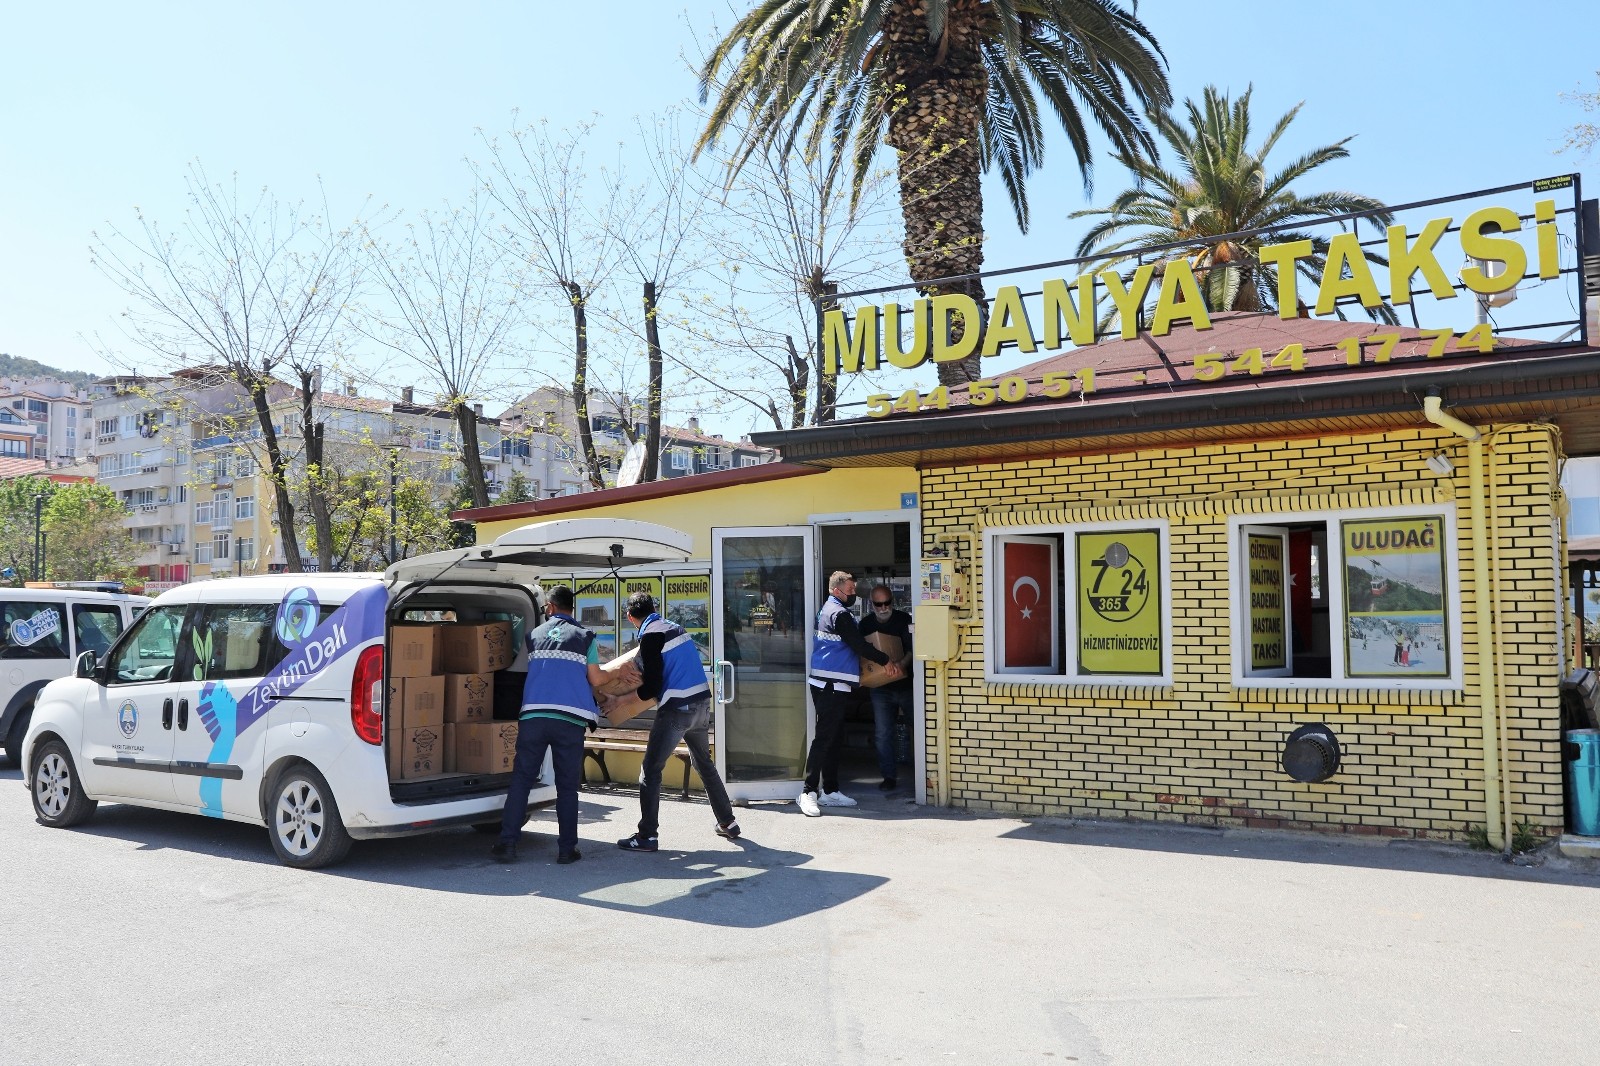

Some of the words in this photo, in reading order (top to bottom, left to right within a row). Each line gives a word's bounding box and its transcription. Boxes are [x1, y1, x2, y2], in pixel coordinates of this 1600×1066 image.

[824, 259, 1213, 376] MUDANYA
[1259, 199, 1561, 320] TAKSİ
[866, 386, 951, 418] 544
[968, 377, 1029, 407] 50
[1042, 367, 1096, 399] 51
[1193, 343, 1308, 382] 544
[1335, 332, 1401, 366] 17
[1418, 323, 1499, 359] 74
[1351, 522, 1436, 551] ULUDAĞ
[1250, 539, 1280, 560] GÜZELYALI
[1091, 559, 1110, 594] 7
[1120, 568, 1147, 596] 24
[1250, 565, 1280, 589] HALİTPAŞA
[578, 583, 615, 595] ANKARA
[626, 582, 653, 593] BURSA
[667, 579, 709, 596] ESKİŞEHİR
[1098, 597, 1122, 611] 365
[1251, 590, 1280, 609] BADEMLİ
[1252, 617, 1281, 634] HASTANE
[1083, 633, 1158, 651] HİZMETİNİZDEYİZ
[1253, 639, 1281, 660] TAKSİ
